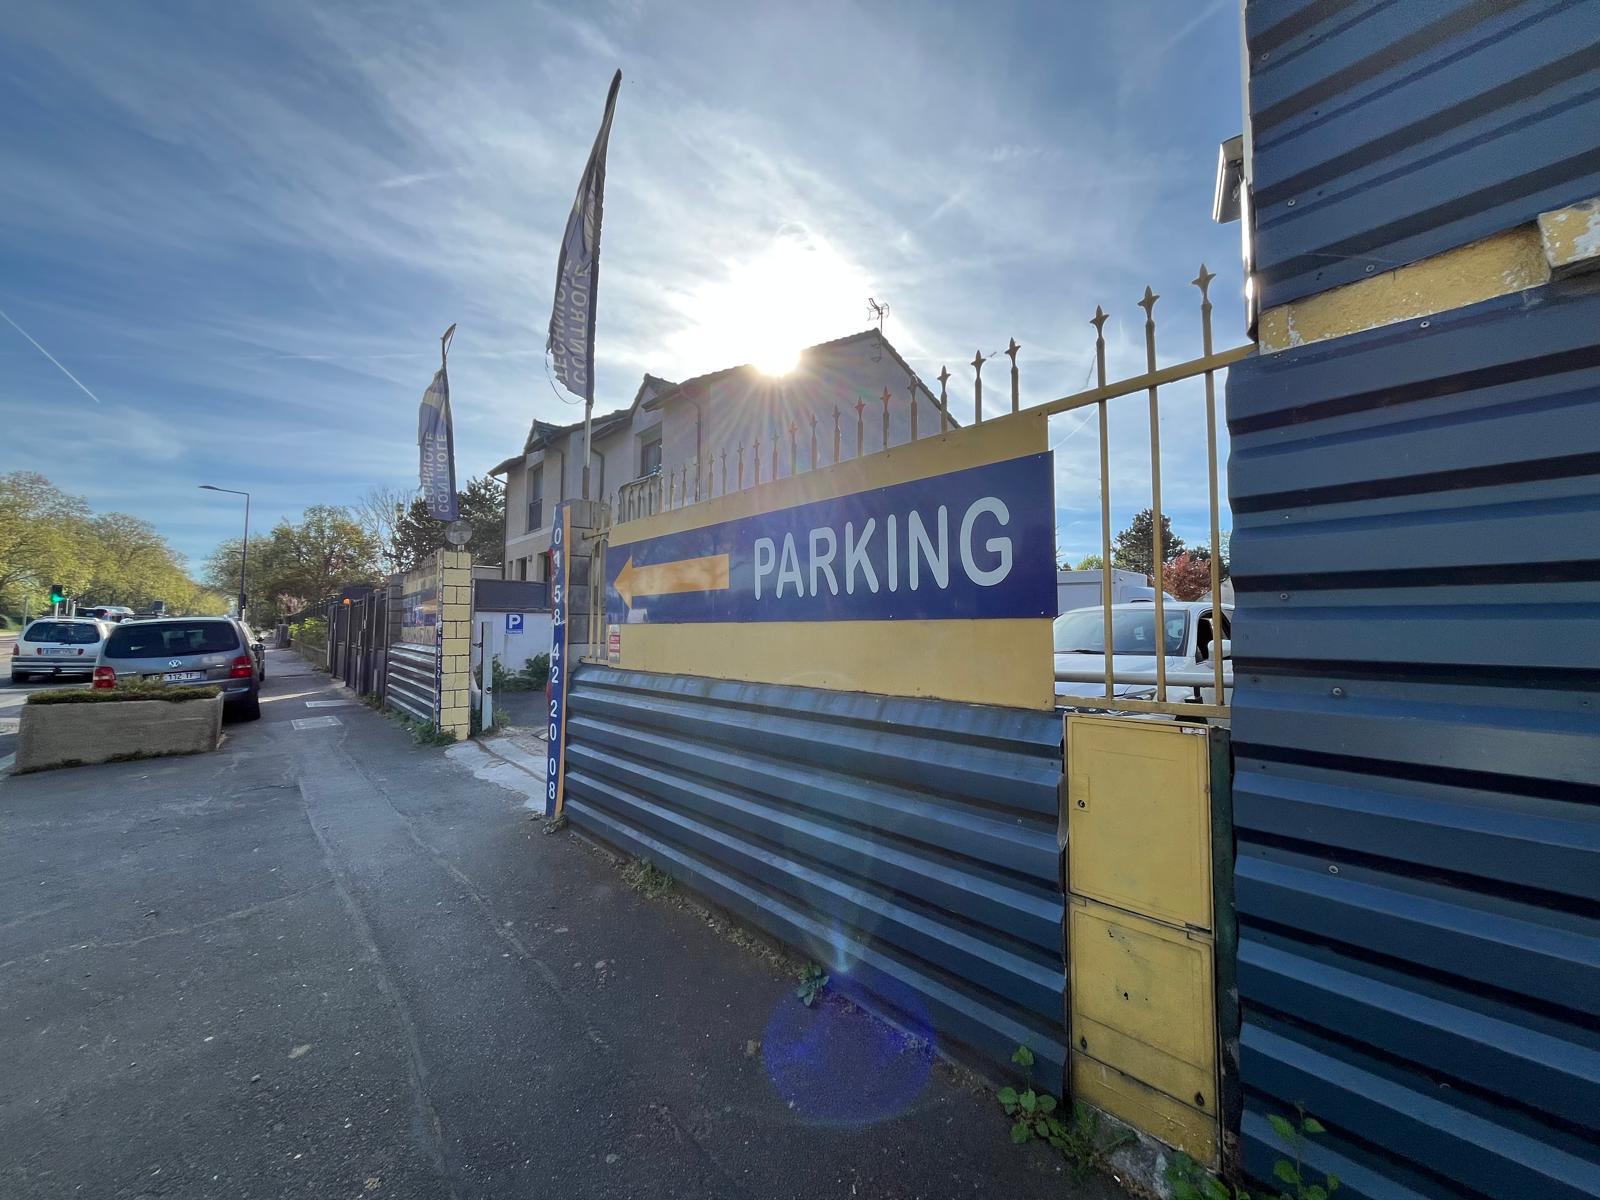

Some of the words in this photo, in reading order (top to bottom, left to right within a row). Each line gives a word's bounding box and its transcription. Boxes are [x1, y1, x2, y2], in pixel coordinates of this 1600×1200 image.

[754, 496, 1013, 600] PARKING
[508, 614, 521, 629] P
[553, 584, 562, 626] 58
[551, 642, 560, 684] 42
[549, 699, 558, 741] 20
[548, 757, 556, 800] 08
